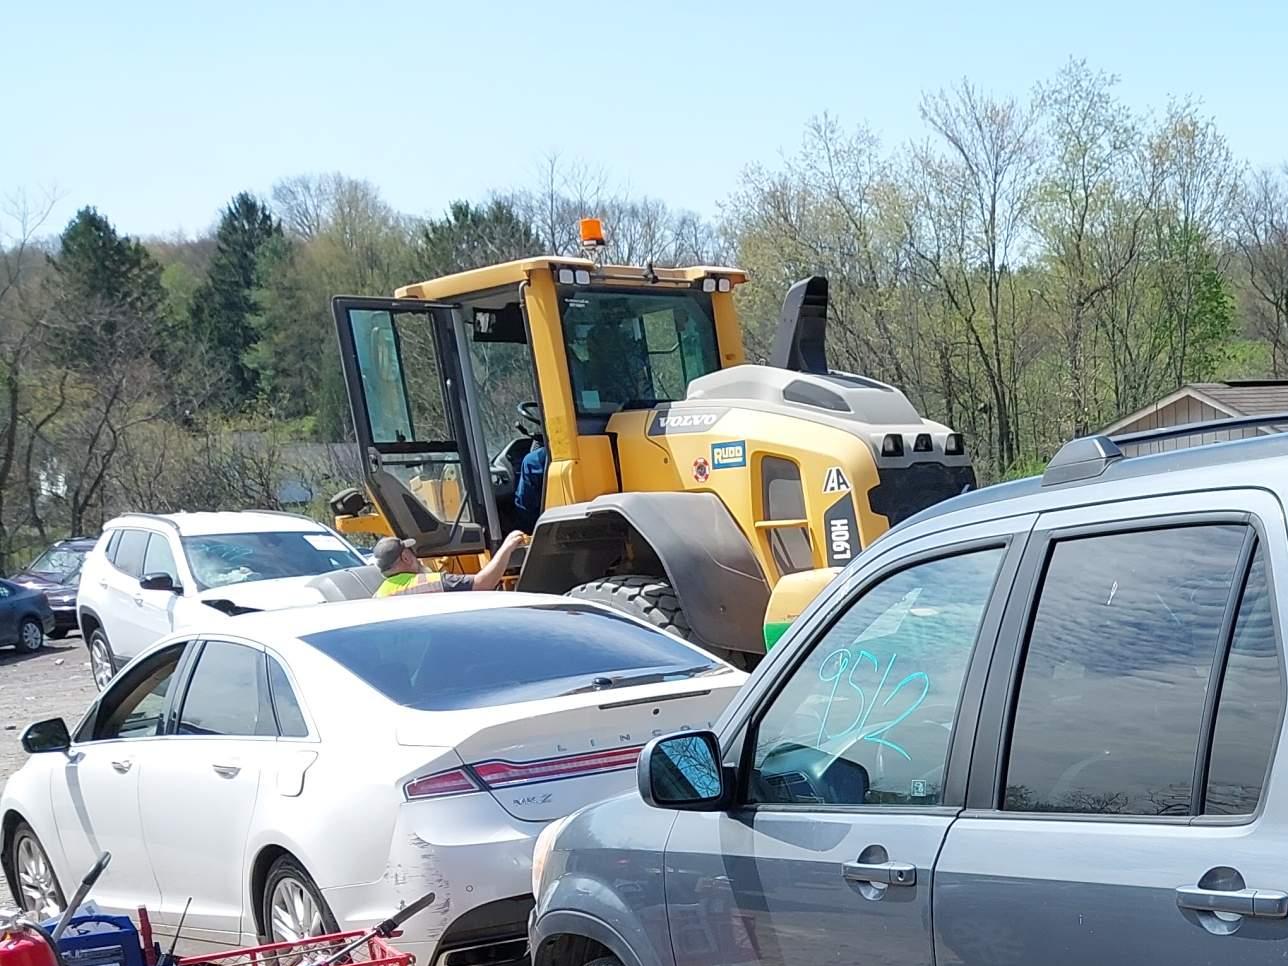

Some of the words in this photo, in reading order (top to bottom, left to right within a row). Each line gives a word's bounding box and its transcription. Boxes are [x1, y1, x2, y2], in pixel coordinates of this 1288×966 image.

[659, 414, 717, 428] VOLVO
[713, 445, 744, 465] RUDD
[830, 518, 853, 561] L90H
[816, 648, 930, 761] 9512
